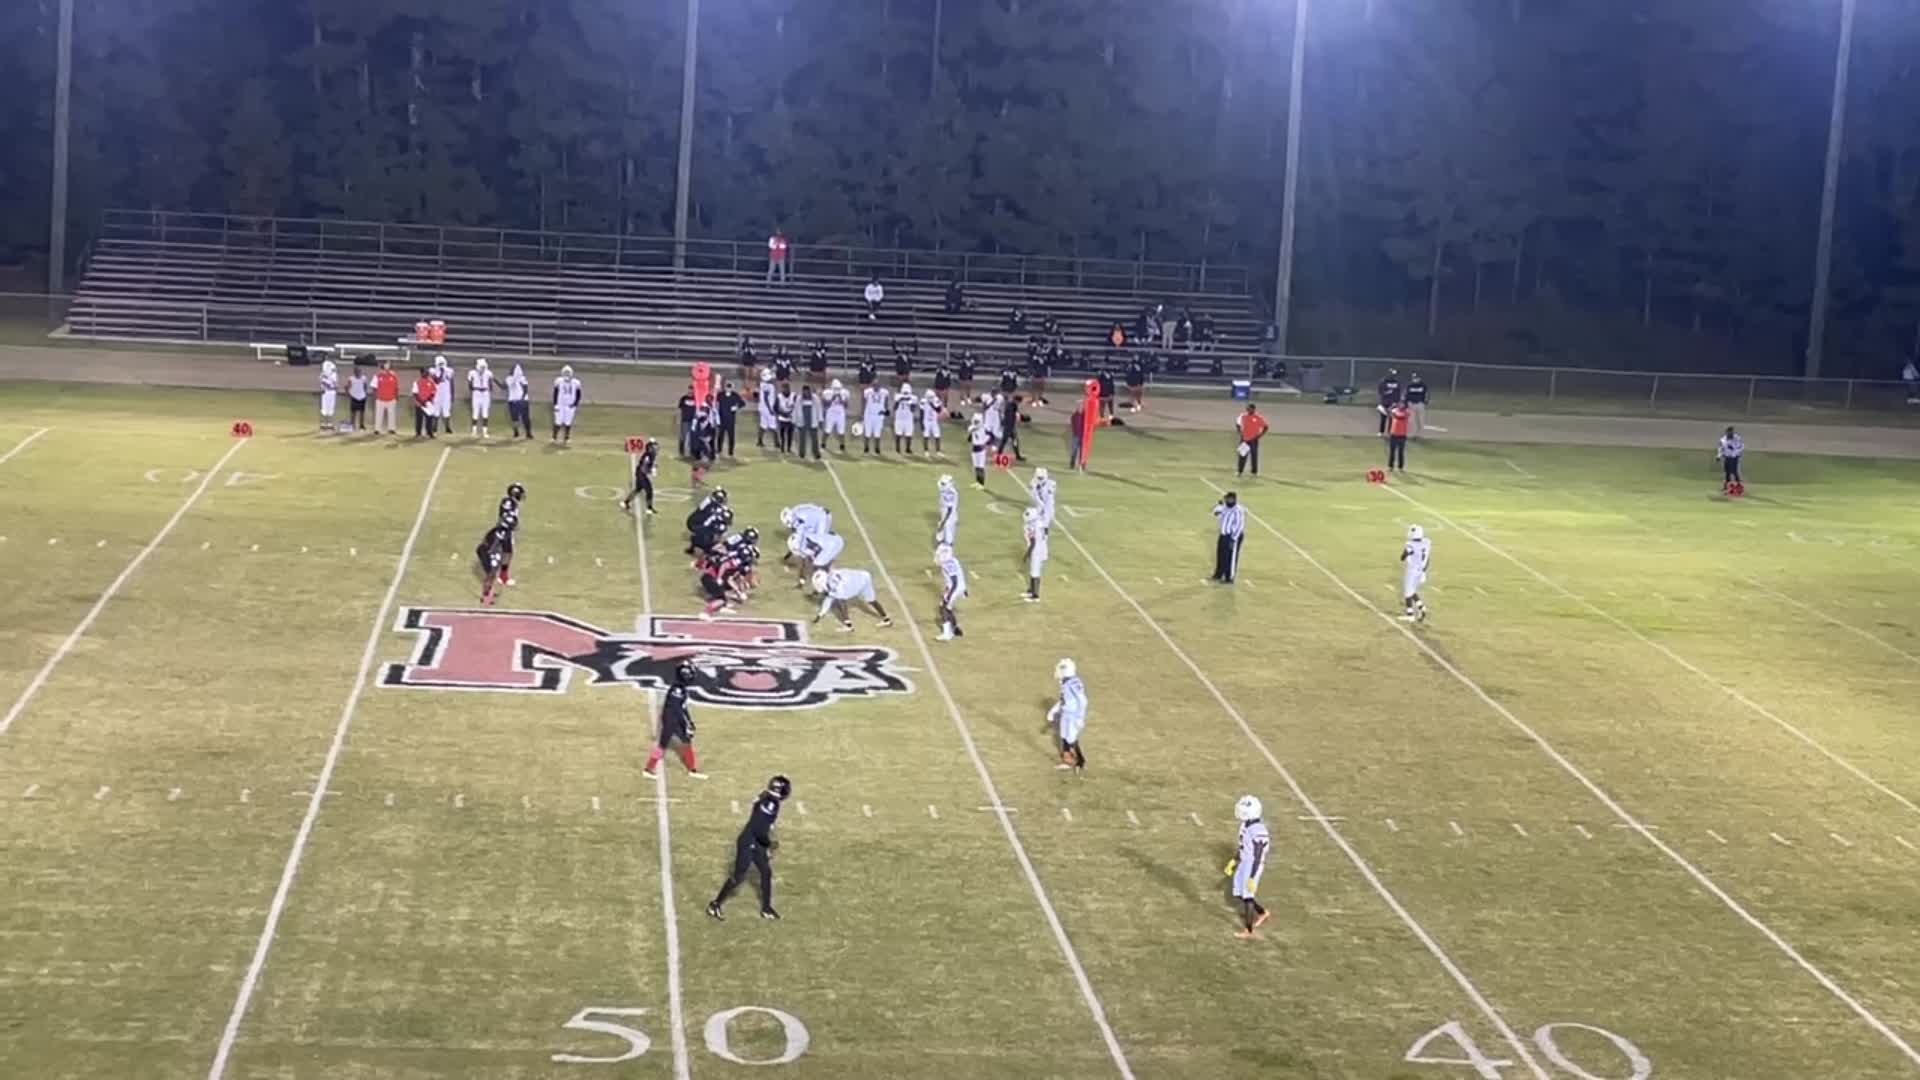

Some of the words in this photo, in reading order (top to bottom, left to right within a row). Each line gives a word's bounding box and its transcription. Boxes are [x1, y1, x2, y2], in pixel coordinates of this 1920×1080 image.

[234, 422, 249, 434] 40
[1370, 470, 1385, 481] 30
[551, 1006, 810, 1065] 50
[1405, 1021, 1651, 1080] 40
